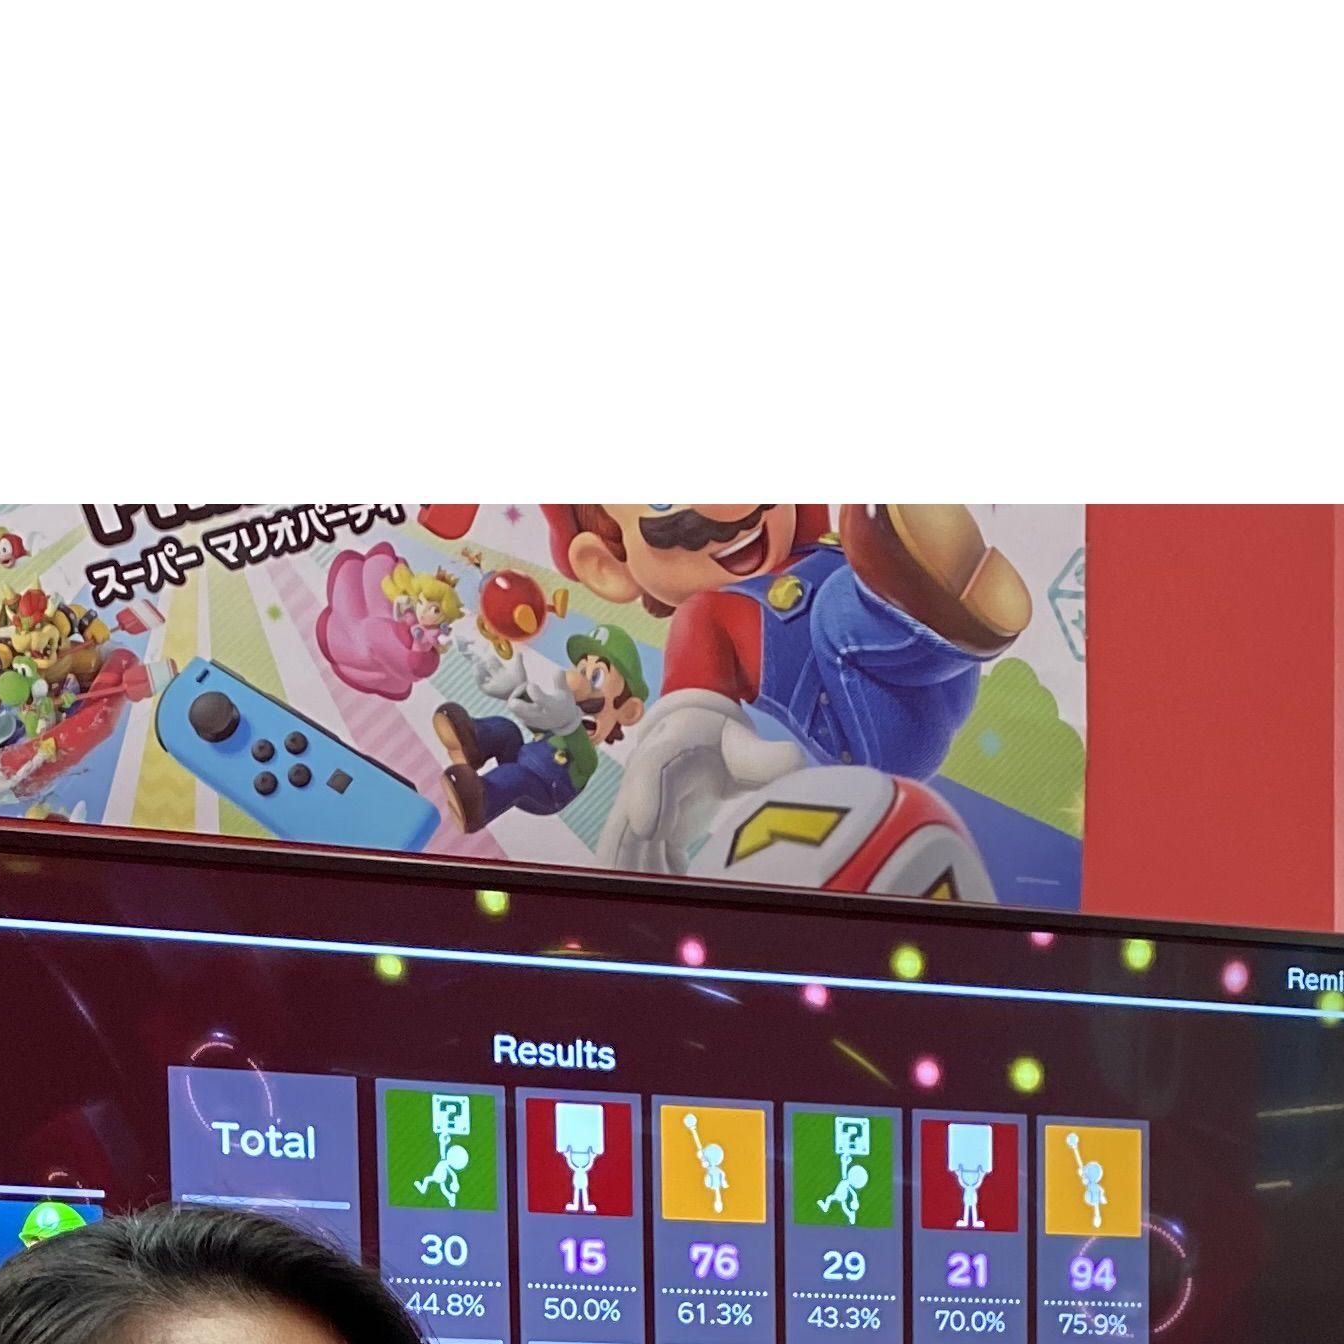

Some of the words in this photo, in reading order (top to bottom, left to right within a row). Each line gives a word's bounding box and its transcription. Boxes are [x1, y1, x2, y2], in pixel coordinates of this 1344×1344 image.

[92, 543, 199, 601] スーパー
[493, 1034, 616, 1070] Results
[210, 1118, 316, 1160] Total
[420, 1234, 468, 1266] 30
[561, 1239, 606, 1273] 15
[691, 1244, 739, 1279] 76
[823, 1250, 866, 1281] 29
[948, 1253, 987, 1288] 21
[1074, 1256, 1115, 1291] 94
[405, 1291, 485, 1317] 44.8%
[544, 1297, 621, 1322] 50.0%
[677, 1301, 753, 1326] 61.3%
[807, 1305, 881, 1330] 43.3%
[935, 1309, 1006, 1333] 70.0%
[1058, 1313, 1128, 1336] 75.9%
